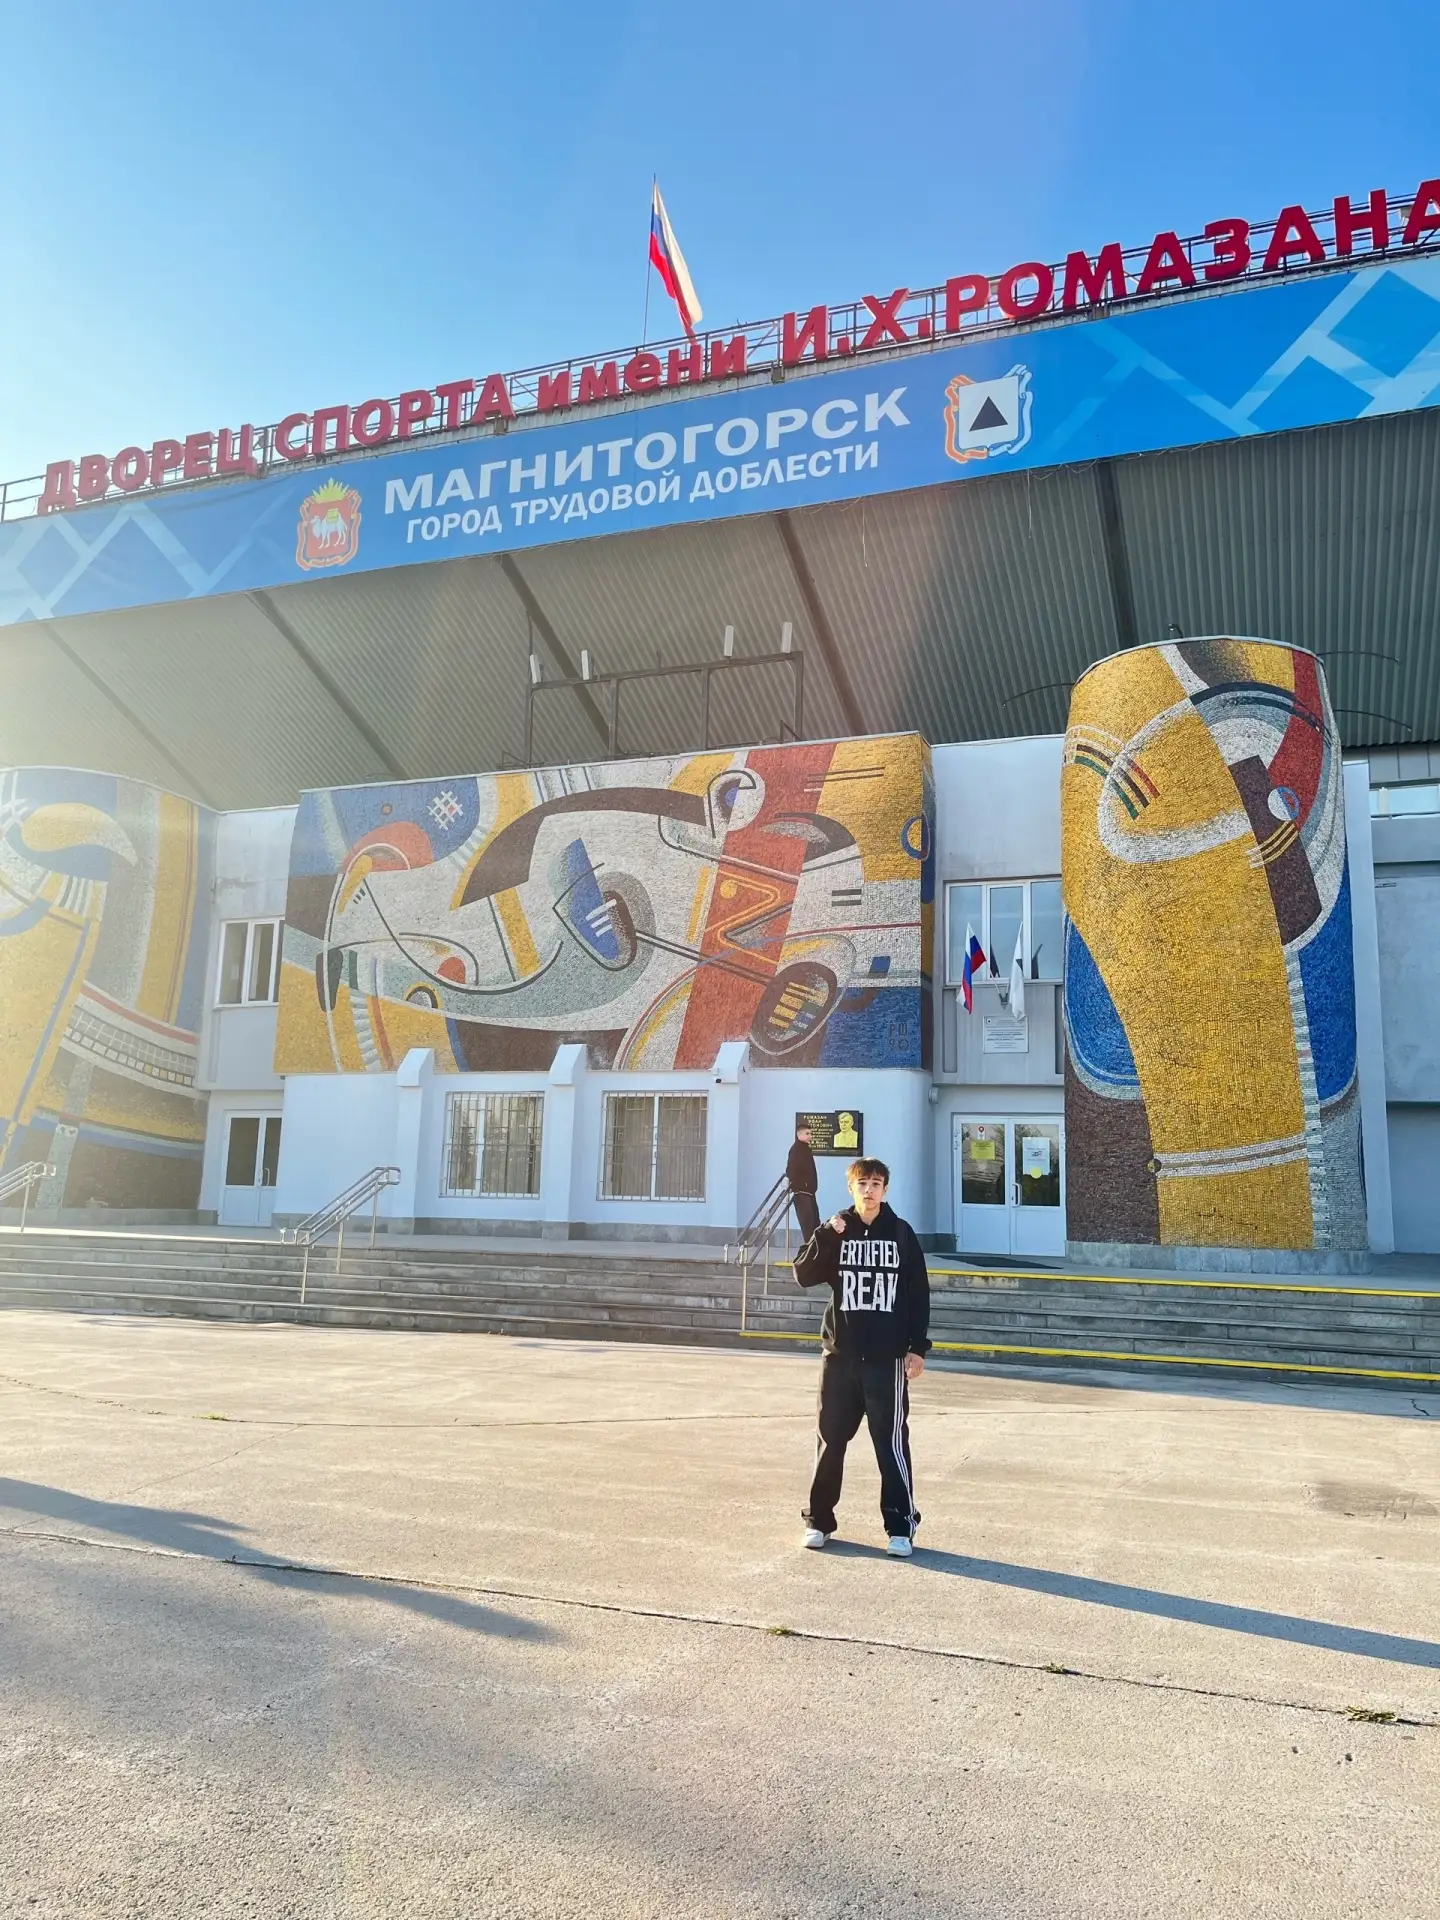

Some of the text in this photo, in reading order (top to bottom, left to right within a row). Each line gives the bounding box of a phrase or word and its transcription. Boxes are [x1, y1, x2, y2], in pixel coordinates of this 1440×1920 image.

[38, 424, 258, 515] ДВОРЕЦ
[275, 373, 516, 460] СПОРТА
[537, 334, 748, 413] имени
[384, 387, 910, 514] МАГНИТОГОРСК
[406, 442, 879, 543] ГОРОД ТРУДОВОЙ ДОБЛЕСТИ
[839, 1239, 900, 1269] ERTIFIED
